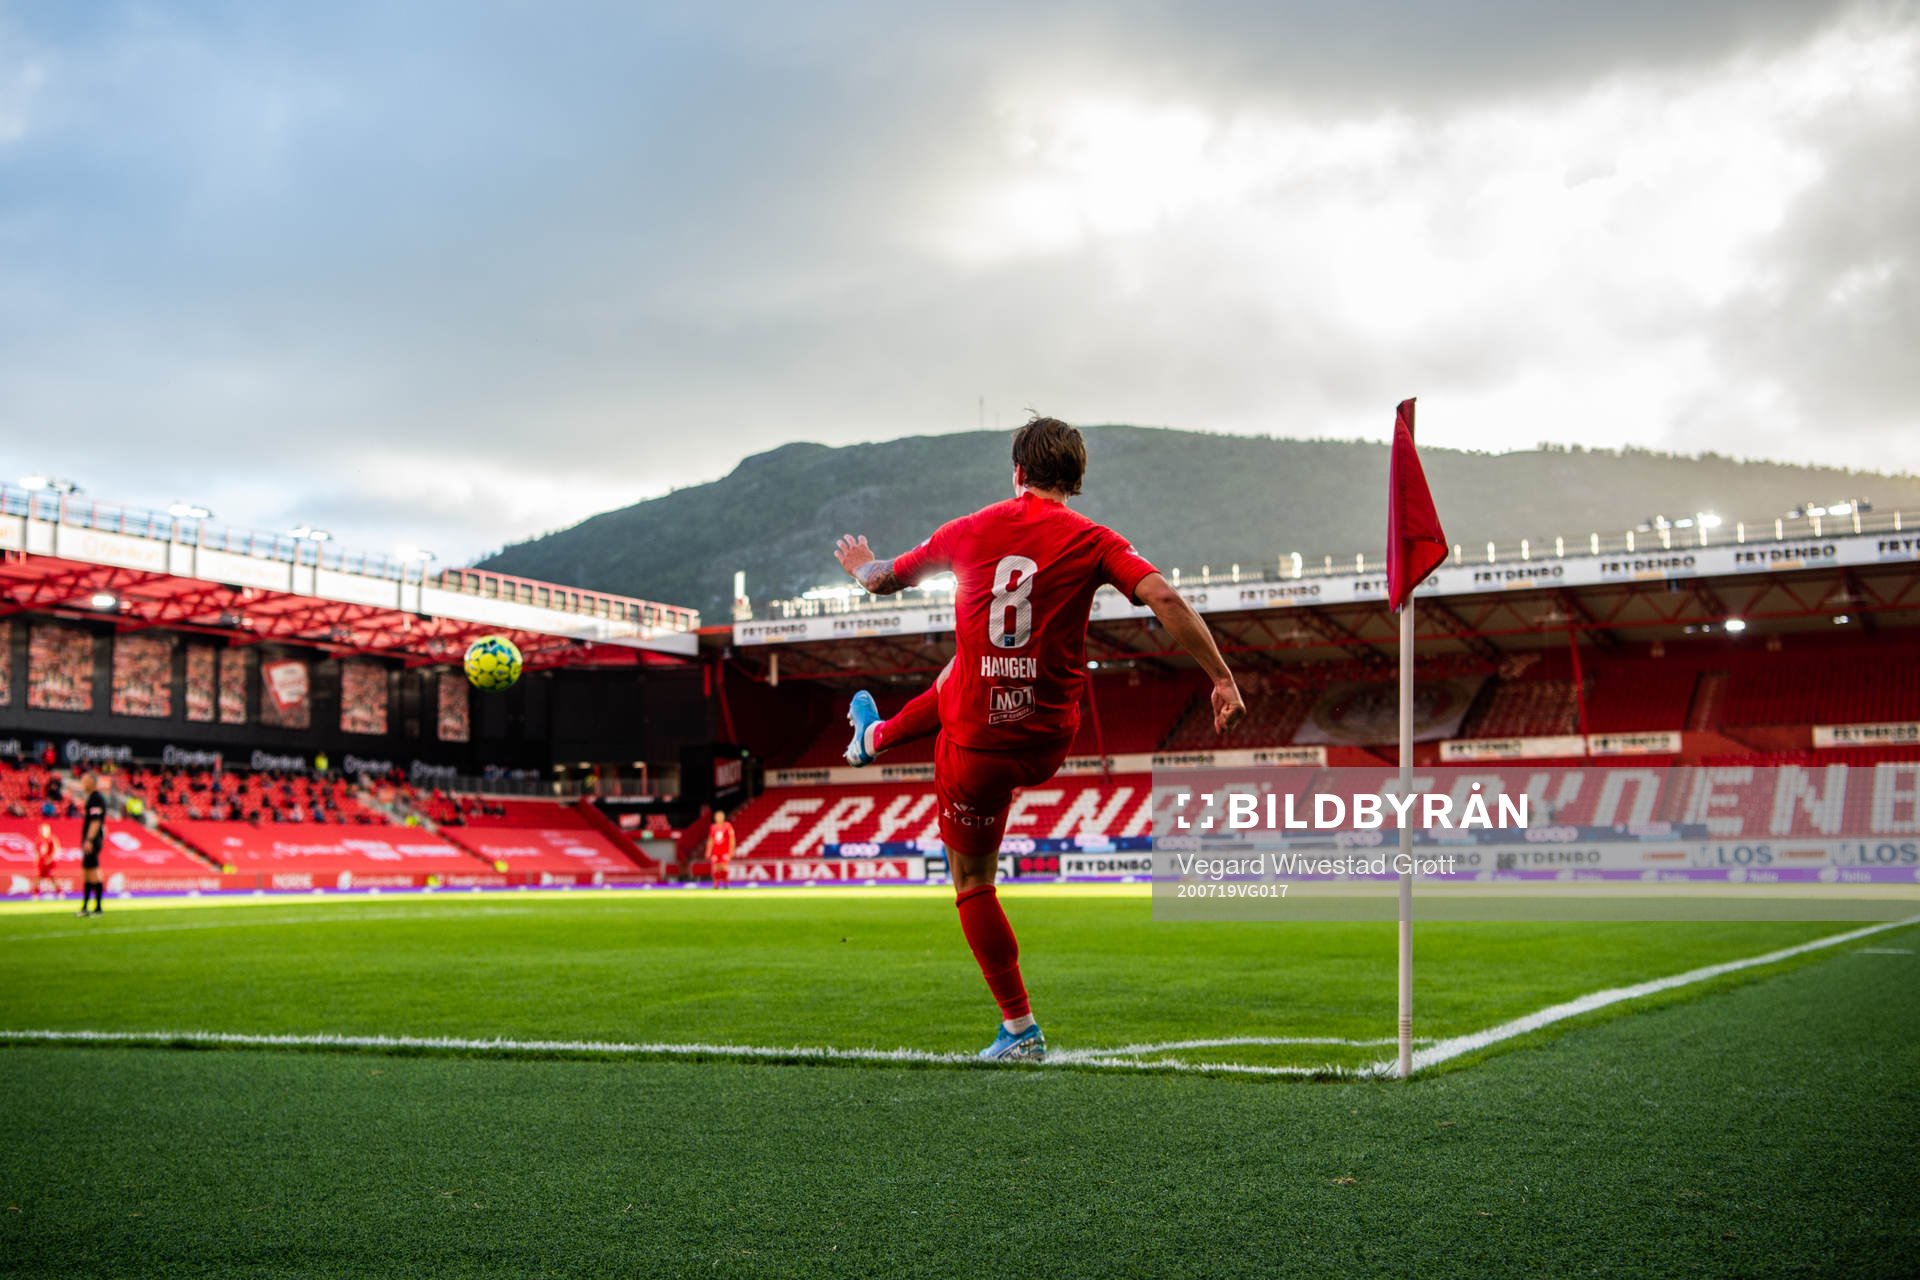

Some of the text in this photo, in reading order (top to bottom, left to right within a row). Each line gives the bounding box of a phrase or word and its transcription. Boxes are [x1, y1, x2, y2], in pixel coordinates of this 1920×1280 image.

[989, 555, 1038, 648] 8
[981, 656, 1036, 678] HAUGEN
[996, 686, 1033, 711] MOT
[1717, 845, 1774, 865] LOS
[1859, 844, 1918, 864] LOS
